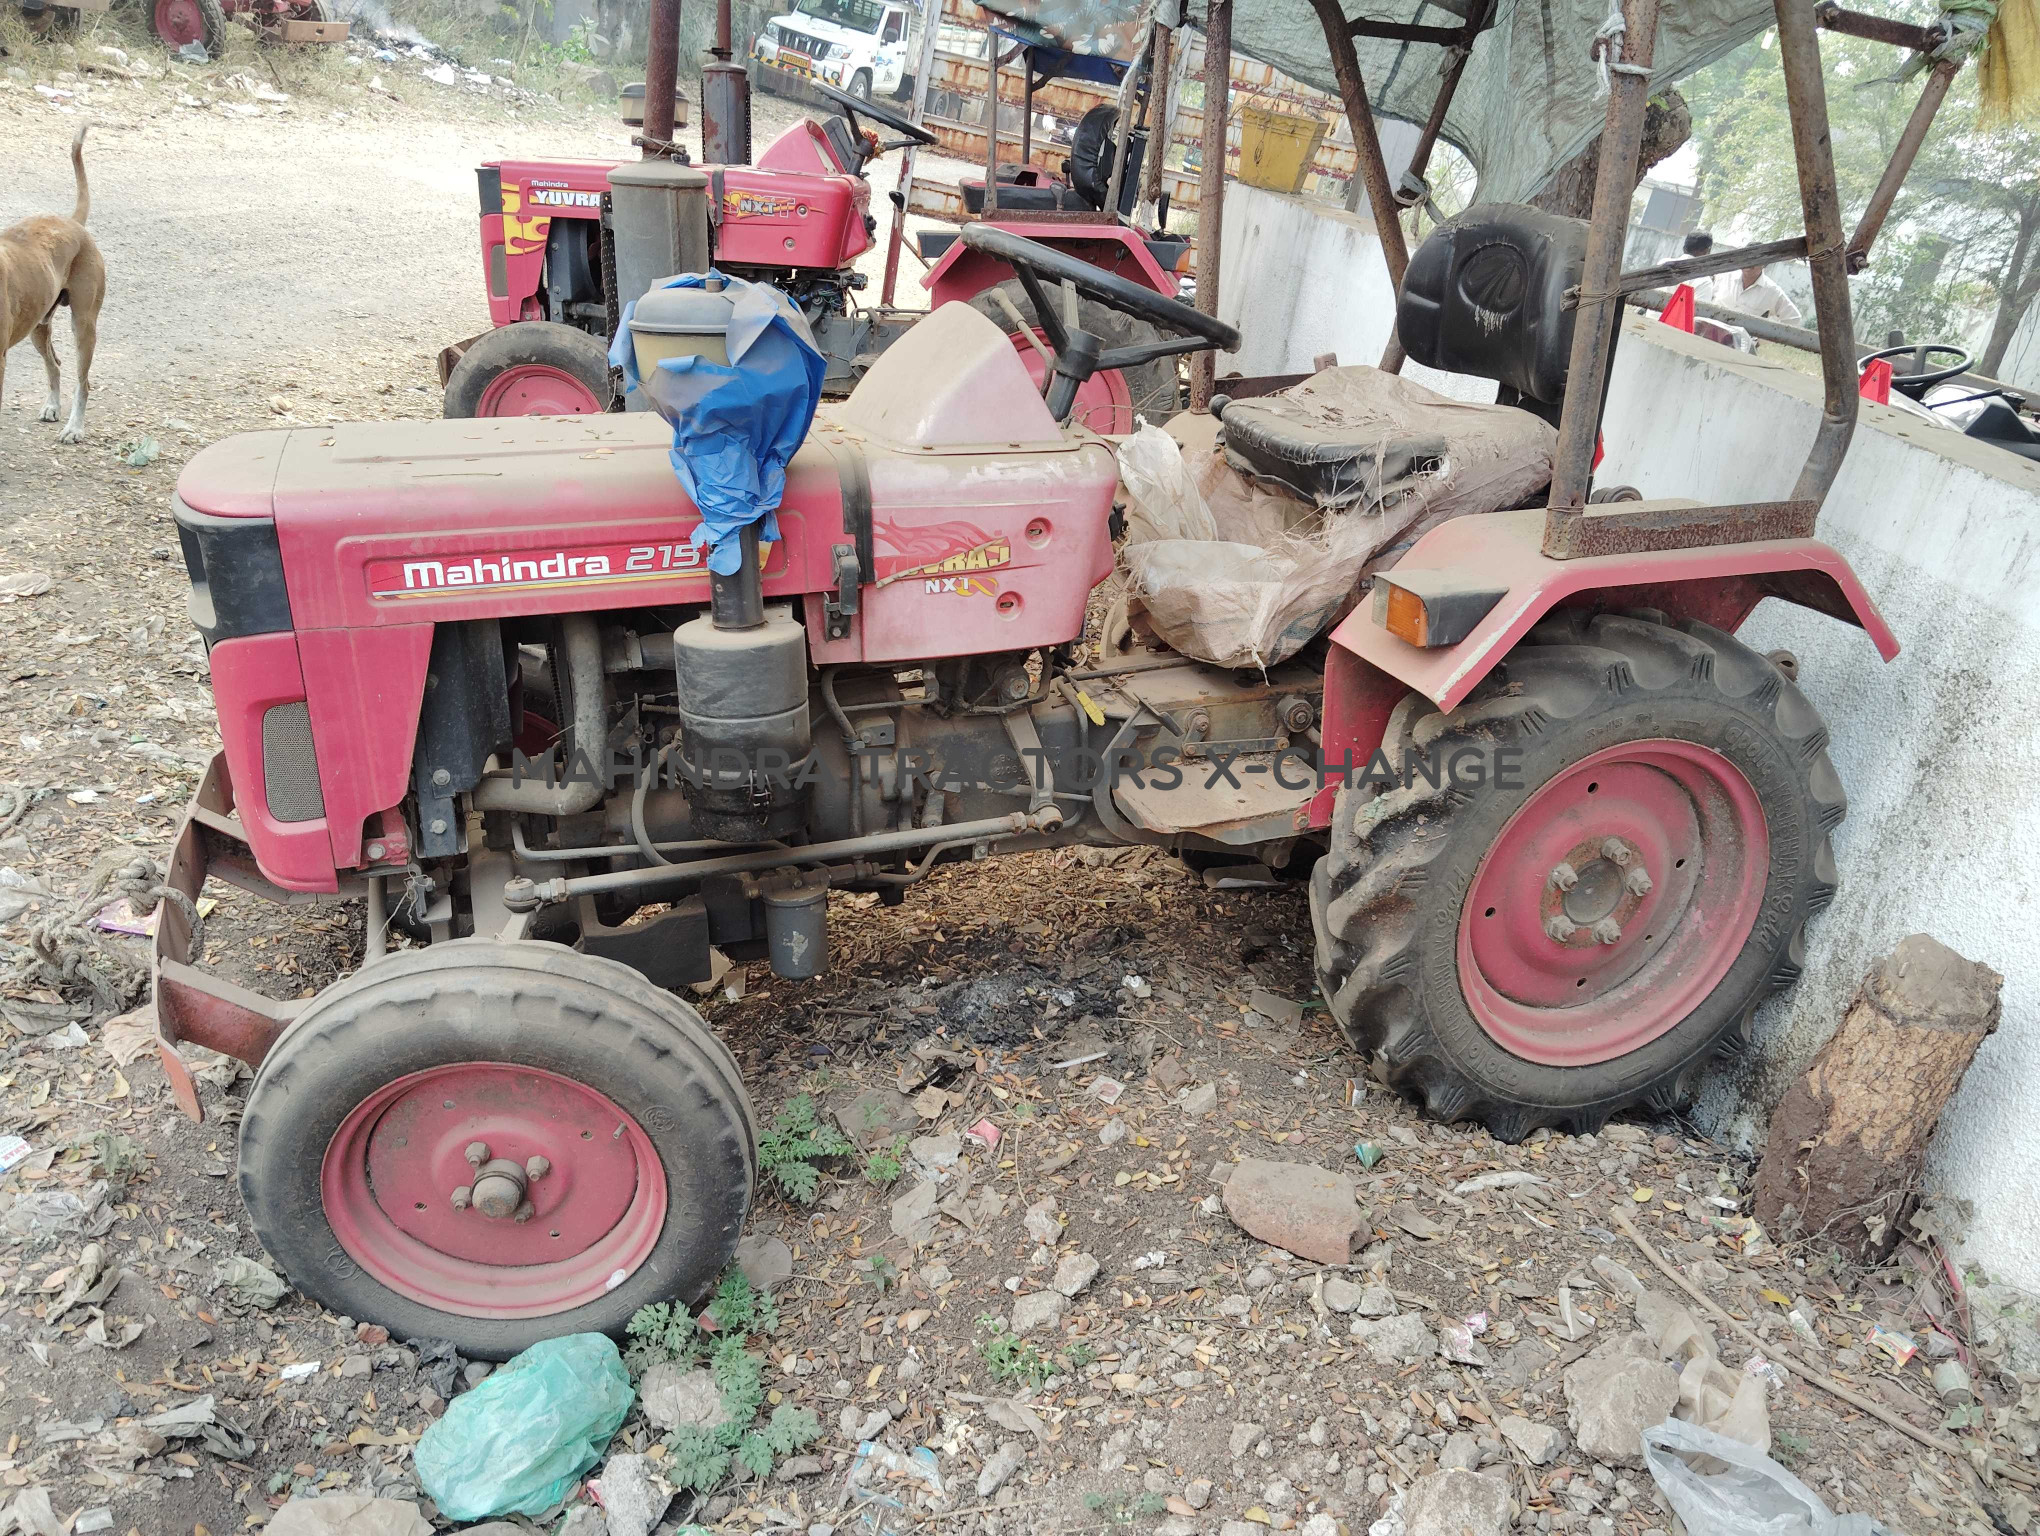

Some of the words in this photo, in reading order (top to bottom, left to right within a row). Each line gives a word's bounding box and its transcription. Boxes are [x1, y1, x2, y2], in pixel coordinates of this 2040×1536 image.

[531, 179, 569, 188] Mahindra
[739, 199, 777, 215] NXT
[403, 553, 610, 588] Mahindra
